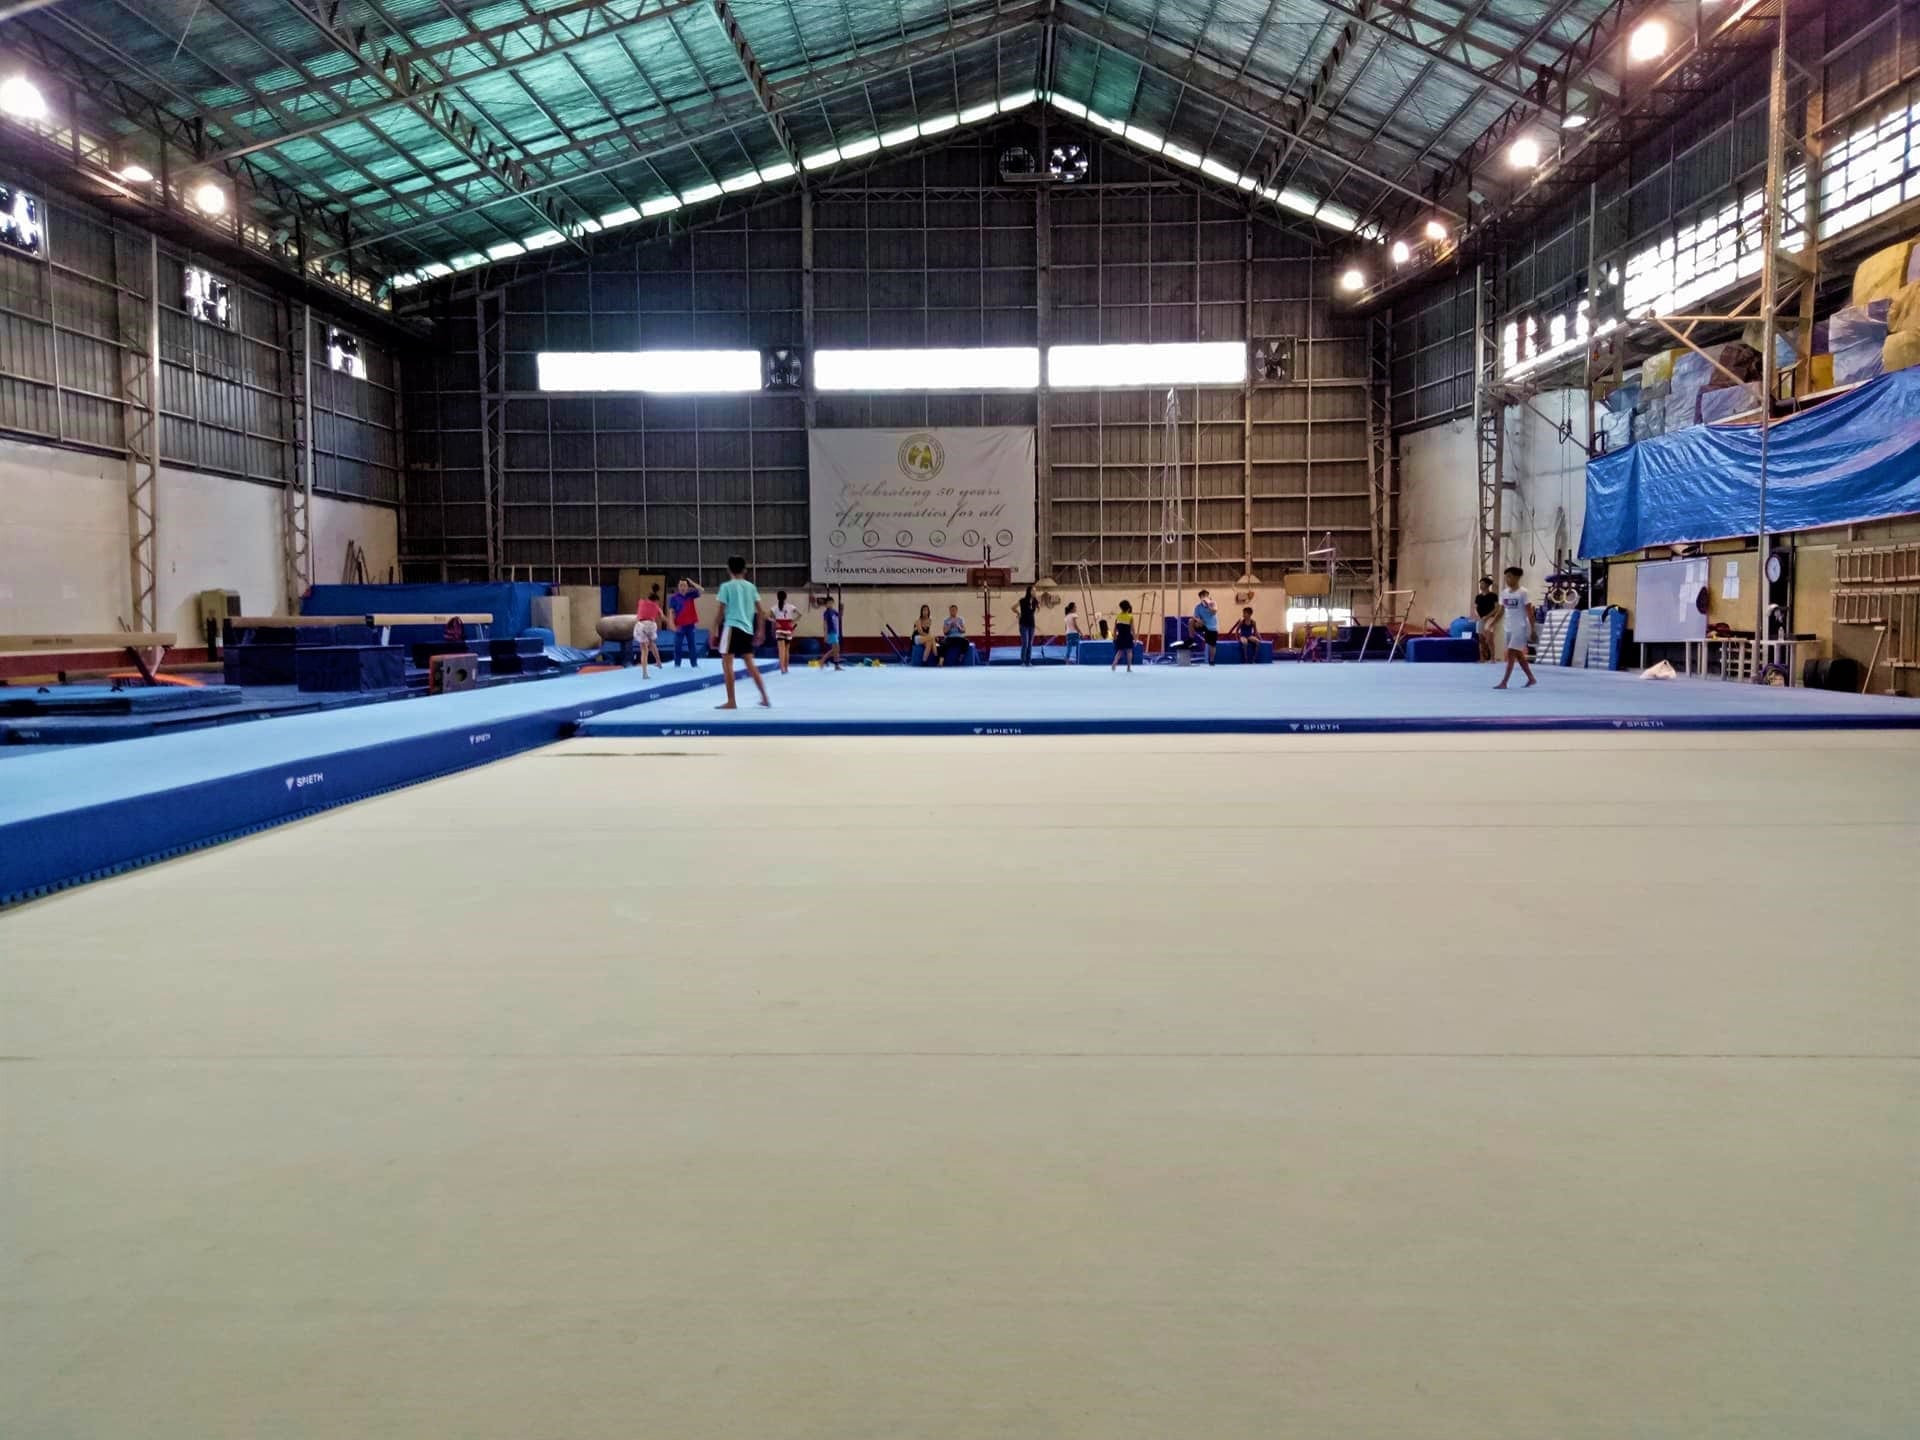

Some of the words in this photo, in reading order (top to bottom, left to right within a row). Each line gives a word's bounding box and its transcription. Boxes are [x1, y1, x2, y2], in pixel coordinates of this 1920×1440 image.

[957, 488, 1000, 506] years
[879, 566, 934, 575] ASSOCIATION
[935, 566, 947, 574] OF
[296, 772, 324, 788] SPIETH
